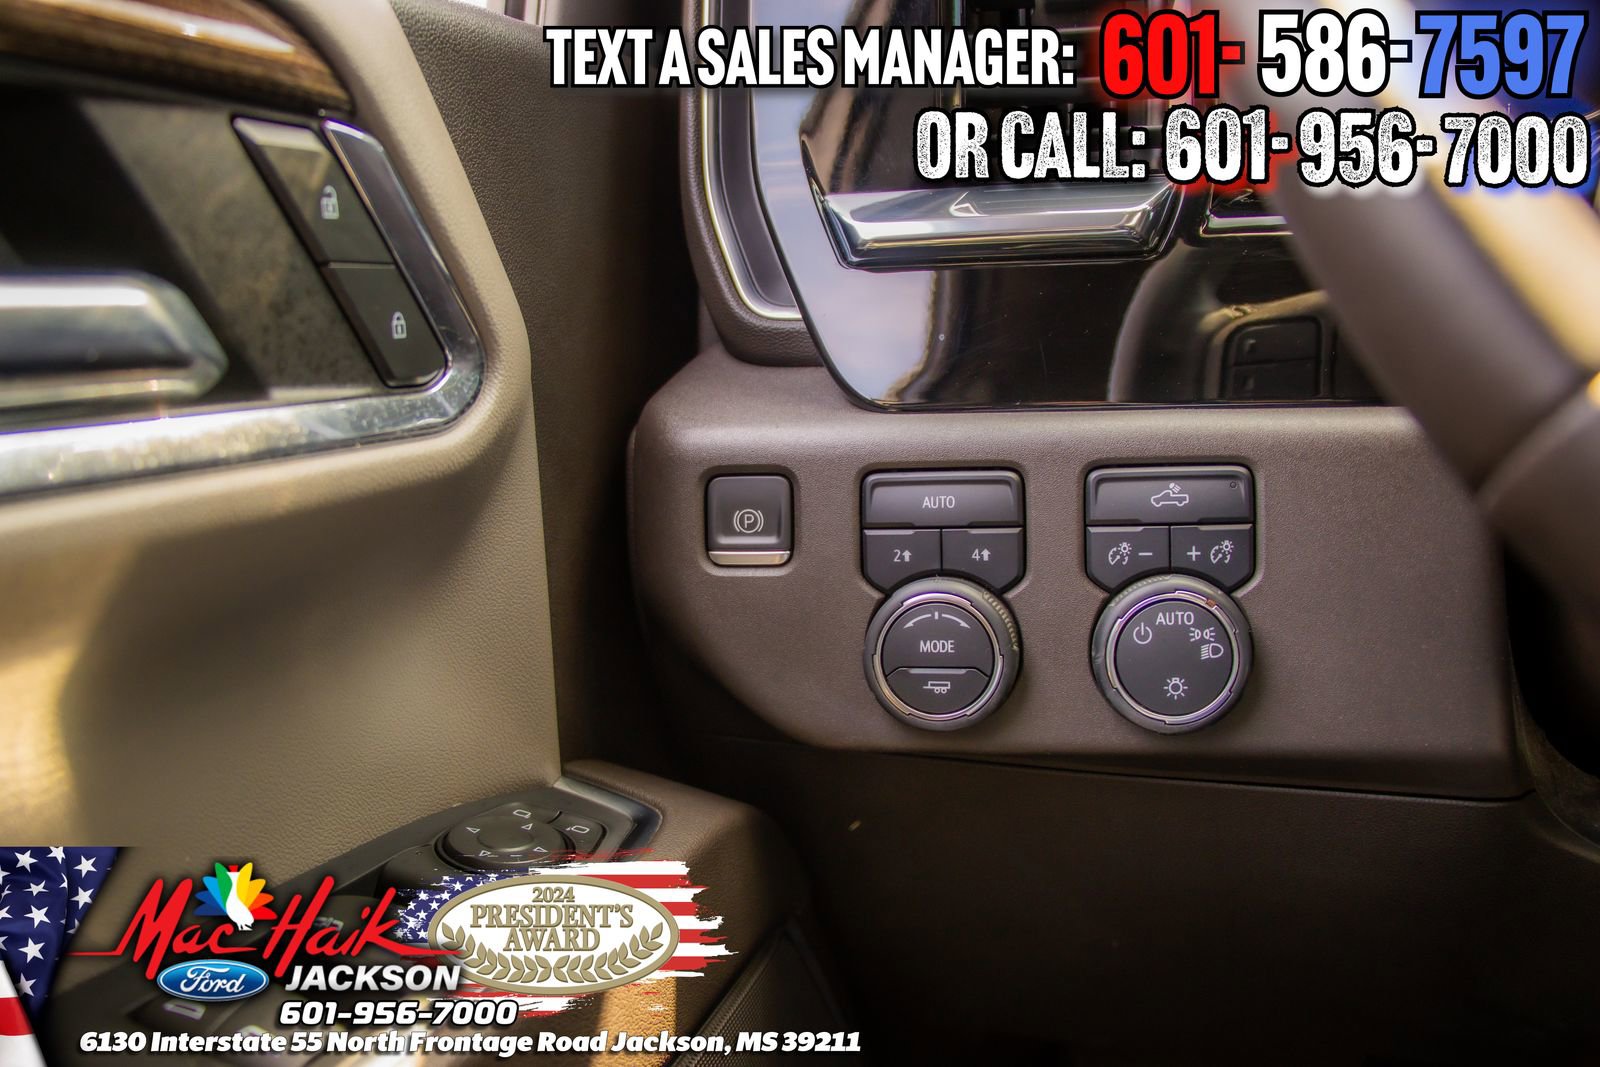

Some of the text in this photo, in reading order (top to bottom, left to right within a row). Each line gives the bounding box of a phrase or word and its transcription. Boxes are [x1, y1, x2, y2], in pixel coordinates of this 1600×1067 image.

[922, 496, 956, 509] AUTO
[1155, 612, 1195, 626] AUTO
[919, 639, 955, 653] MODE
